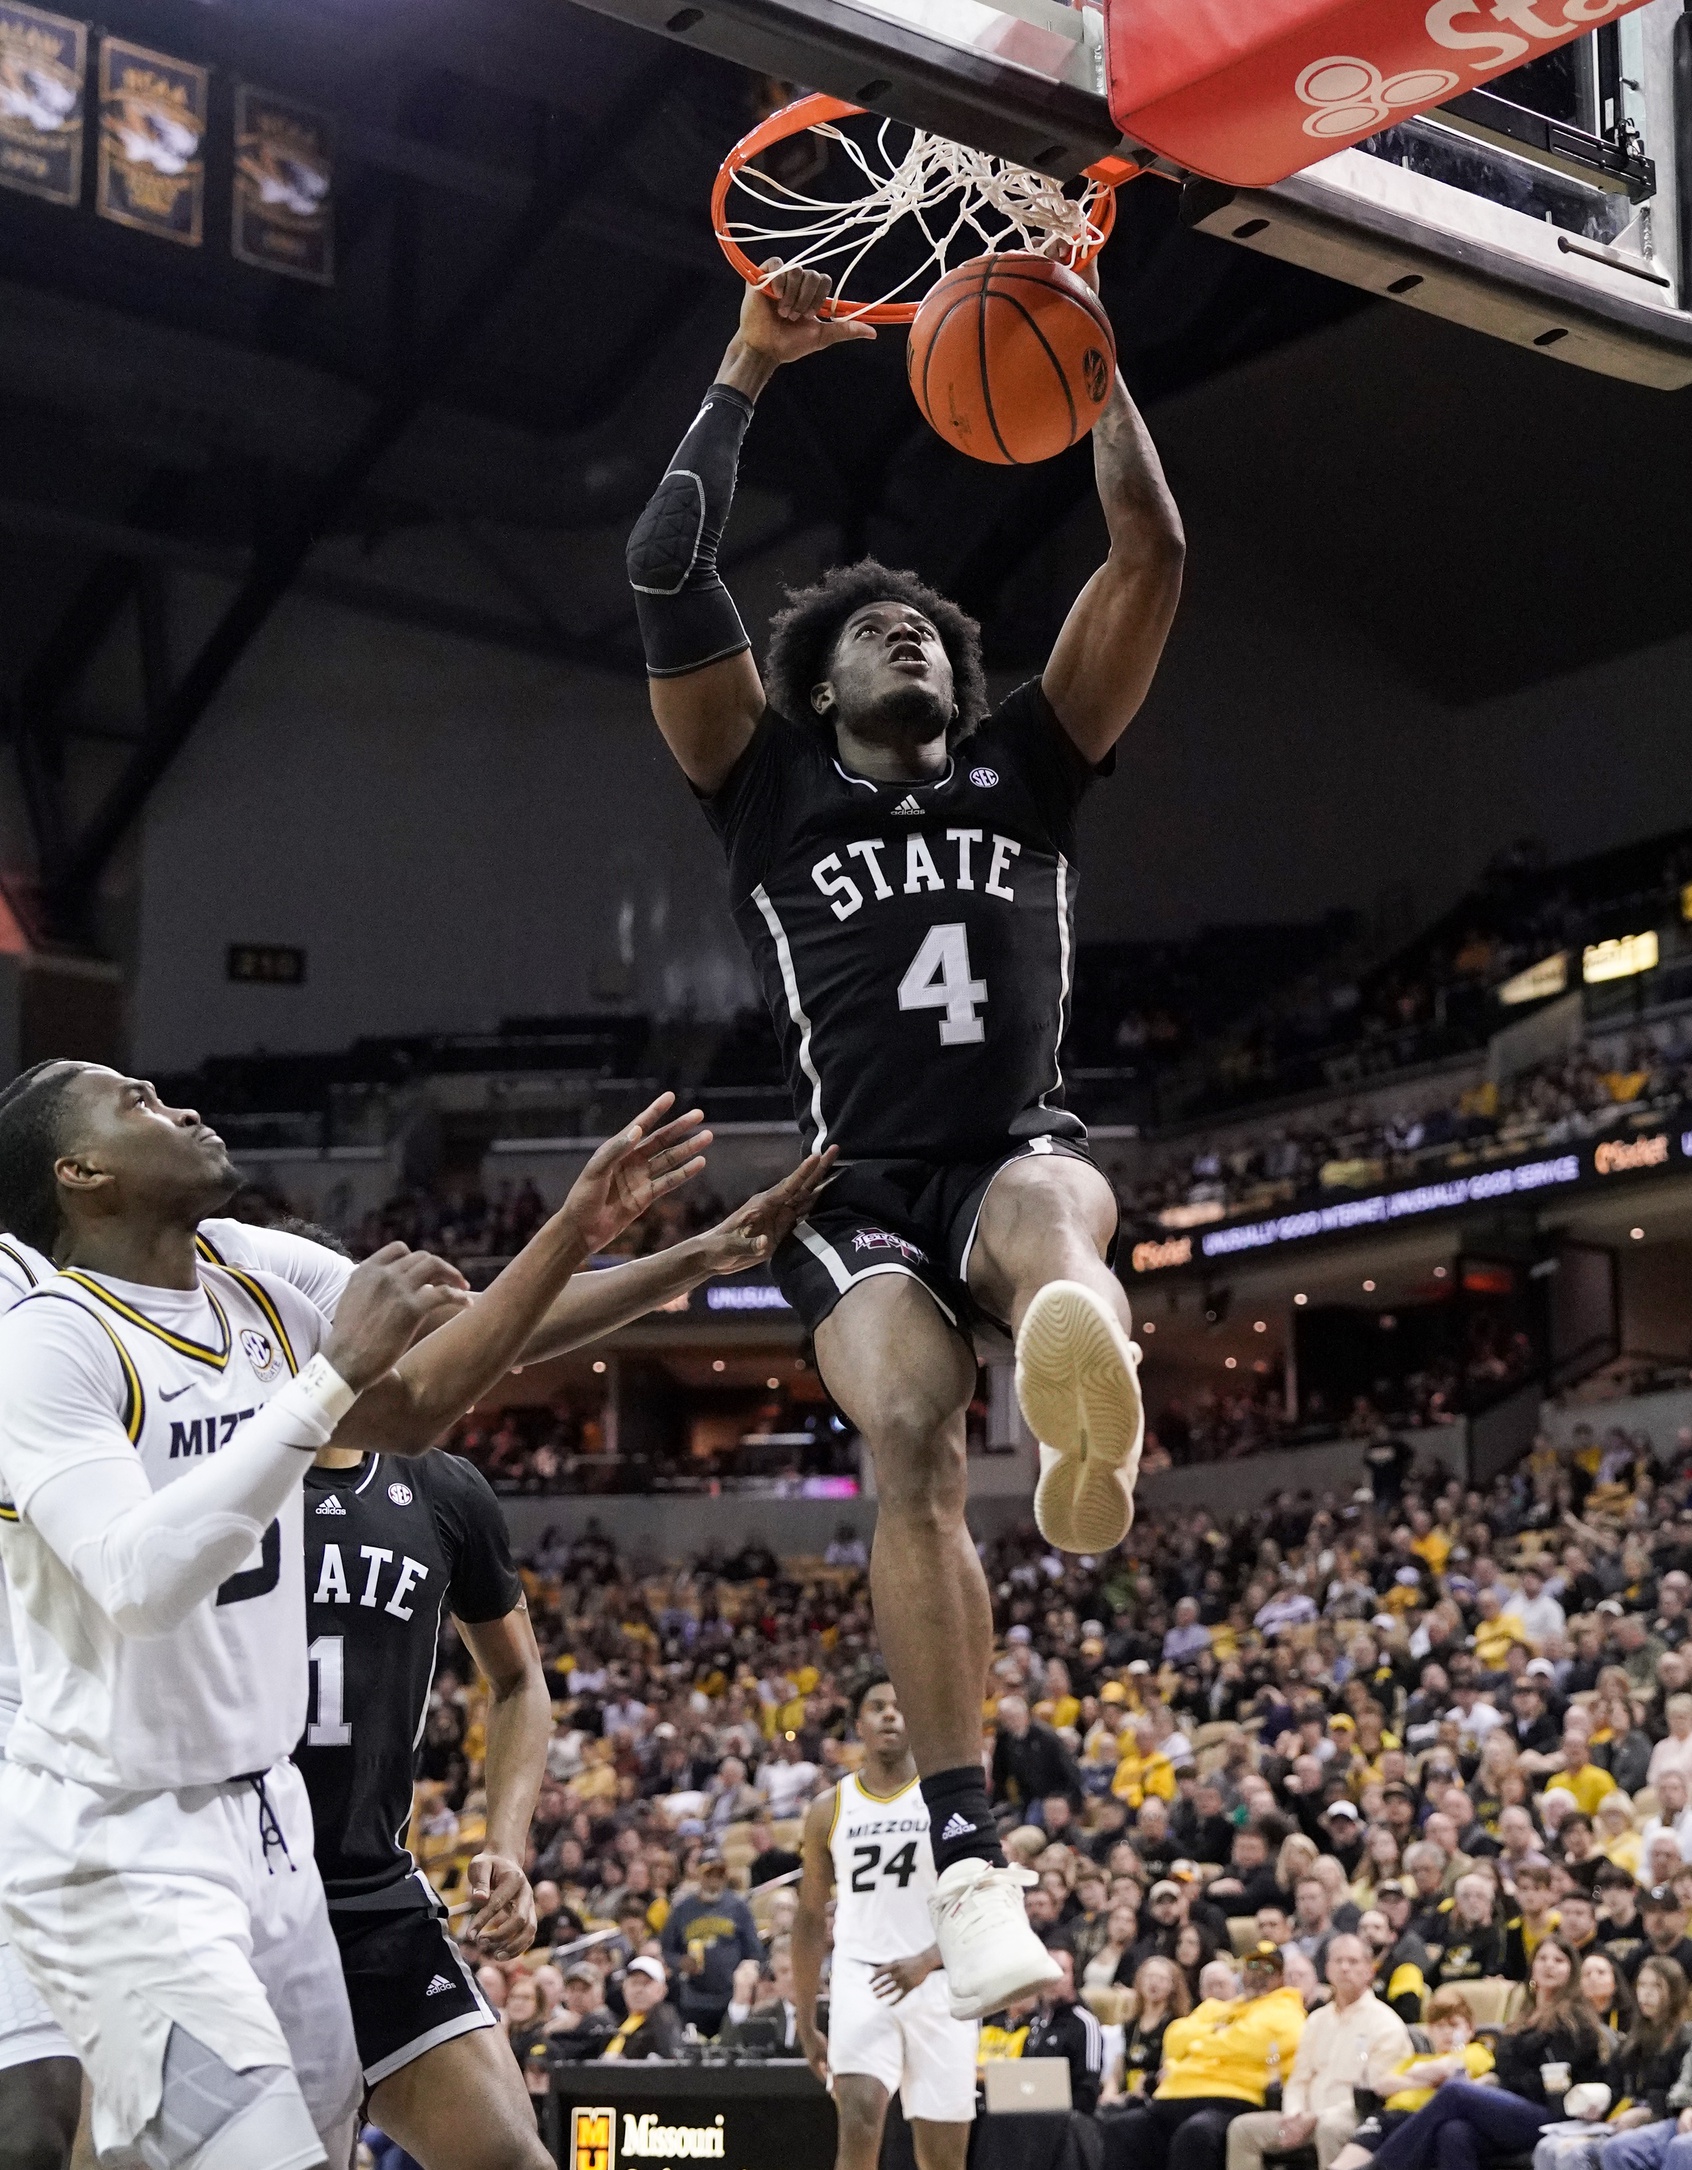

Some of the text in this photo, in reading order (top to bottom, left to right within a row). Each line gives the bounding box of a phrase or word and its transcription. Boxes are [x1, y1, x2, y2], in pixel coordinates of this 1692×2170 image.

[971, 768, 997, 787] SEC
[890, 808, 926, 816] adidas
[811, 828, 1021, 921] STATE
[897, 922, 989, 1046] 4
[241, 1330, 271, 1368] SEC
[169, 1402, 264, 1459] MIZ
[315, 1506, 347, 1516] adidas
[389, 1484, 411, 1505] SEC
[313, 1543, 429, 1622] ATE
[308, 1635, 352, 1747] 1
[848, 1818, 929, 1840] MIZZOU
[942, 1823, 977, 1841] adidas
[852, 1841, 918, 1893] 24
[425, 1981, 457, 1997] adidas
[620, 2113, 725, 2159] Missouri
